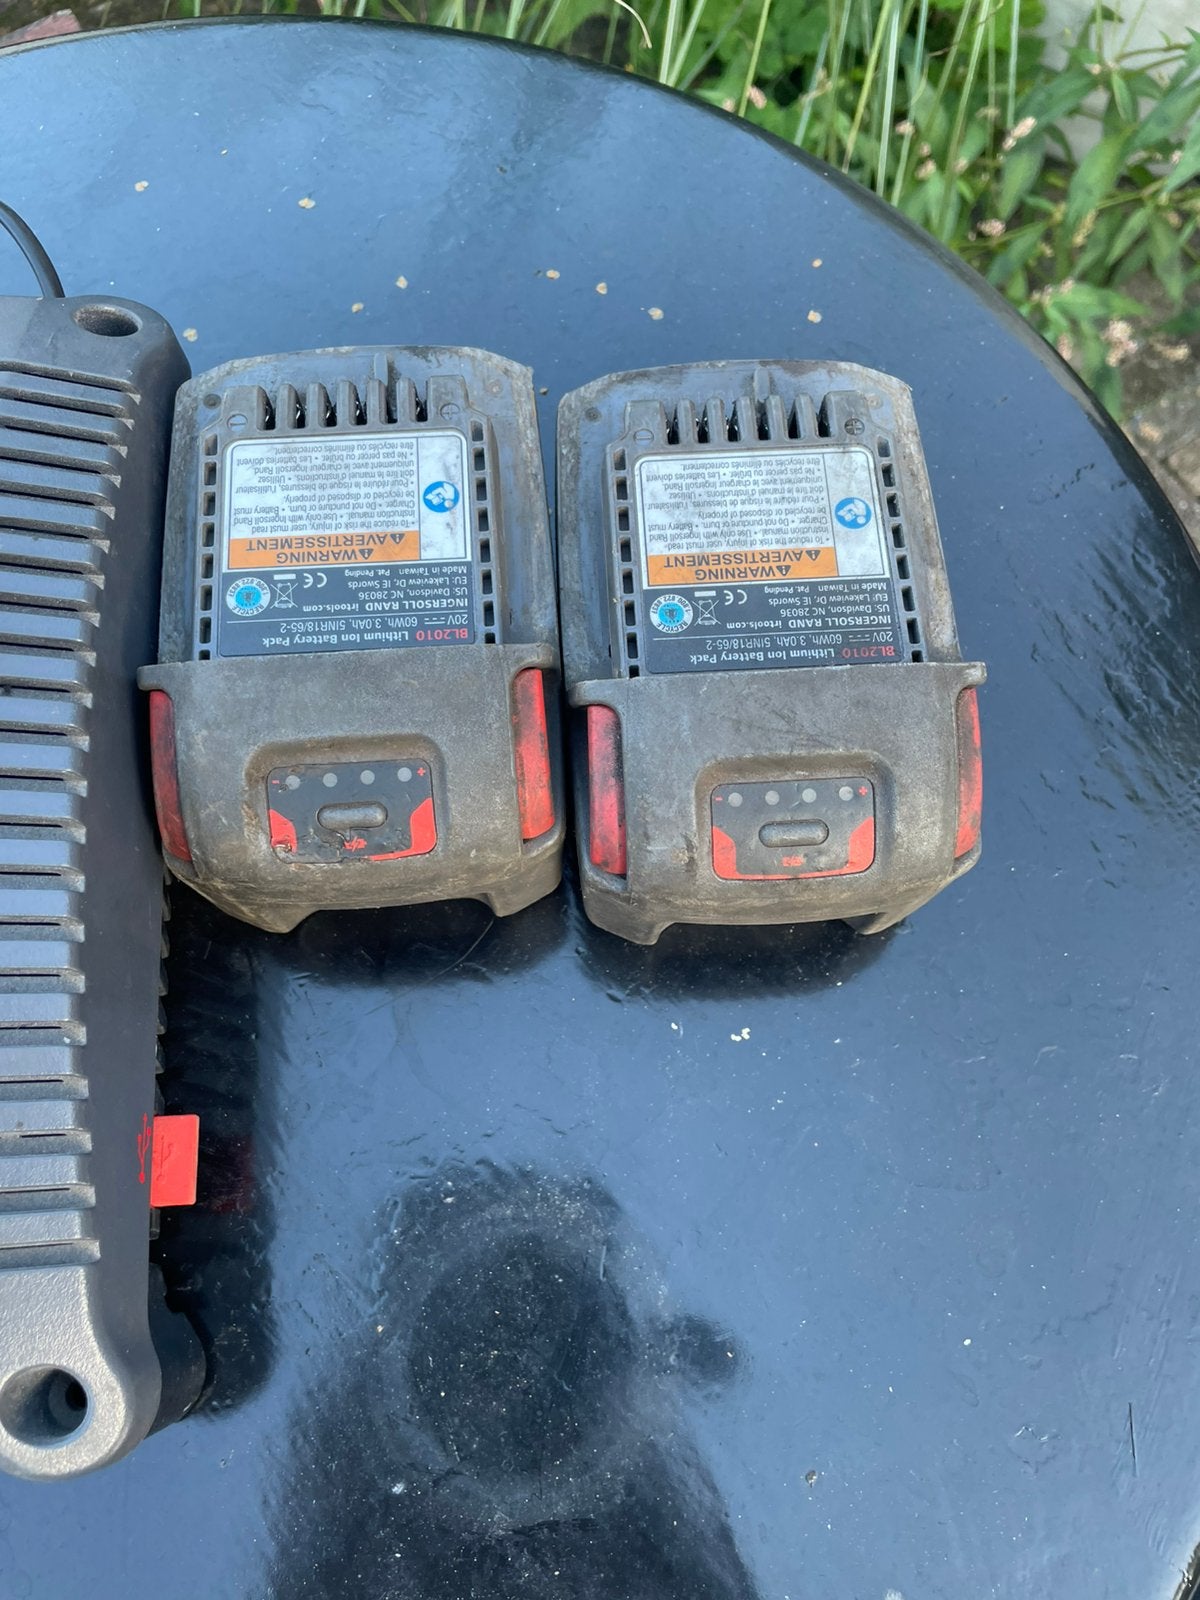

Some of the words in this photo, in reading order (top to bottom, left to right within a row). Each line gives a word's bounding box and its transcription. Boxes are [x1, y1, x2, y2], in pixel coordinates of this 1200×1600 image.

[246, 533, 386, 551] AVERTISSEMENT
[276, 549, 357, 564] WARNING
[663, 550, 803, 568] AVERTISSEMENT
[345, 568, 374, 578] Pending
[376, 569, 390, 577] Pat.
[399, 567, 429, 576] Taiwan
[432, 567, 440, 575] in
[442, 566, 467, 574] Made
[694, 565, 775, 580] WARNING
[348, 580, 379, 590] Swords
[382, 580, 390, 588] IE
[394, 578, 406, 588] Dr,
[408, 577, 449, 587] Lakeview
[452, 576, 467, 585] EU:
[453, 587, 468, 595] US:
[764, 585, 794, 595] Pending
[818, 584, 849, 593] Taiwan
[861, 582, 887, 591] Made
[358, 591, 387, 600] 28036
[390, 590, 403, 598] NC
[407, 587, 450, 598] Davidson,
[872, 593, 888, 602] EU:
[403, 598, 468, 609] INGERSOLL
[768, 597, 801, 607] Swords
[802, 597, 811, 605] IE
[814, 595, 827, 604] Dr,
[828, 594, 870, 604] Lakeview
[303, 603, 358, 614] irtools.com
[365, 601, 398, 611] RAND
[812, 607, 825, 615] NC
[828, 604, 872, 615] Davidson,
[874, 604, 889, 612] US:
[780, 608, 810, 617] 28036
[447, 614, 468, 625] 20V
[788, 618, 822, 628] RAND
[825, 615, 891, 626] INGERSOLL
[280, 620, 345, 633] 5INR18/65-2
[655, 621, 689, 633] RECYCLE
[726, 620, 782, 631] irtools.com
[293, 632, 337, 645] Battery
[341, 633, 359, 643] Ion
[364, 631, 408, 642] Lithium
[416, 628, 469, 641] BL2010
[871, 631, 893, 642] 20V
[262, 637, 289, 647] Pack
[705, 637, 771, 650] 5INR18/65-2
[690, 654, 717, 664] Pack
[720, 650, 764, 662] Battery
[768, 650, 786, 660] Ion
[790, 648, 835, 660] Lithium
